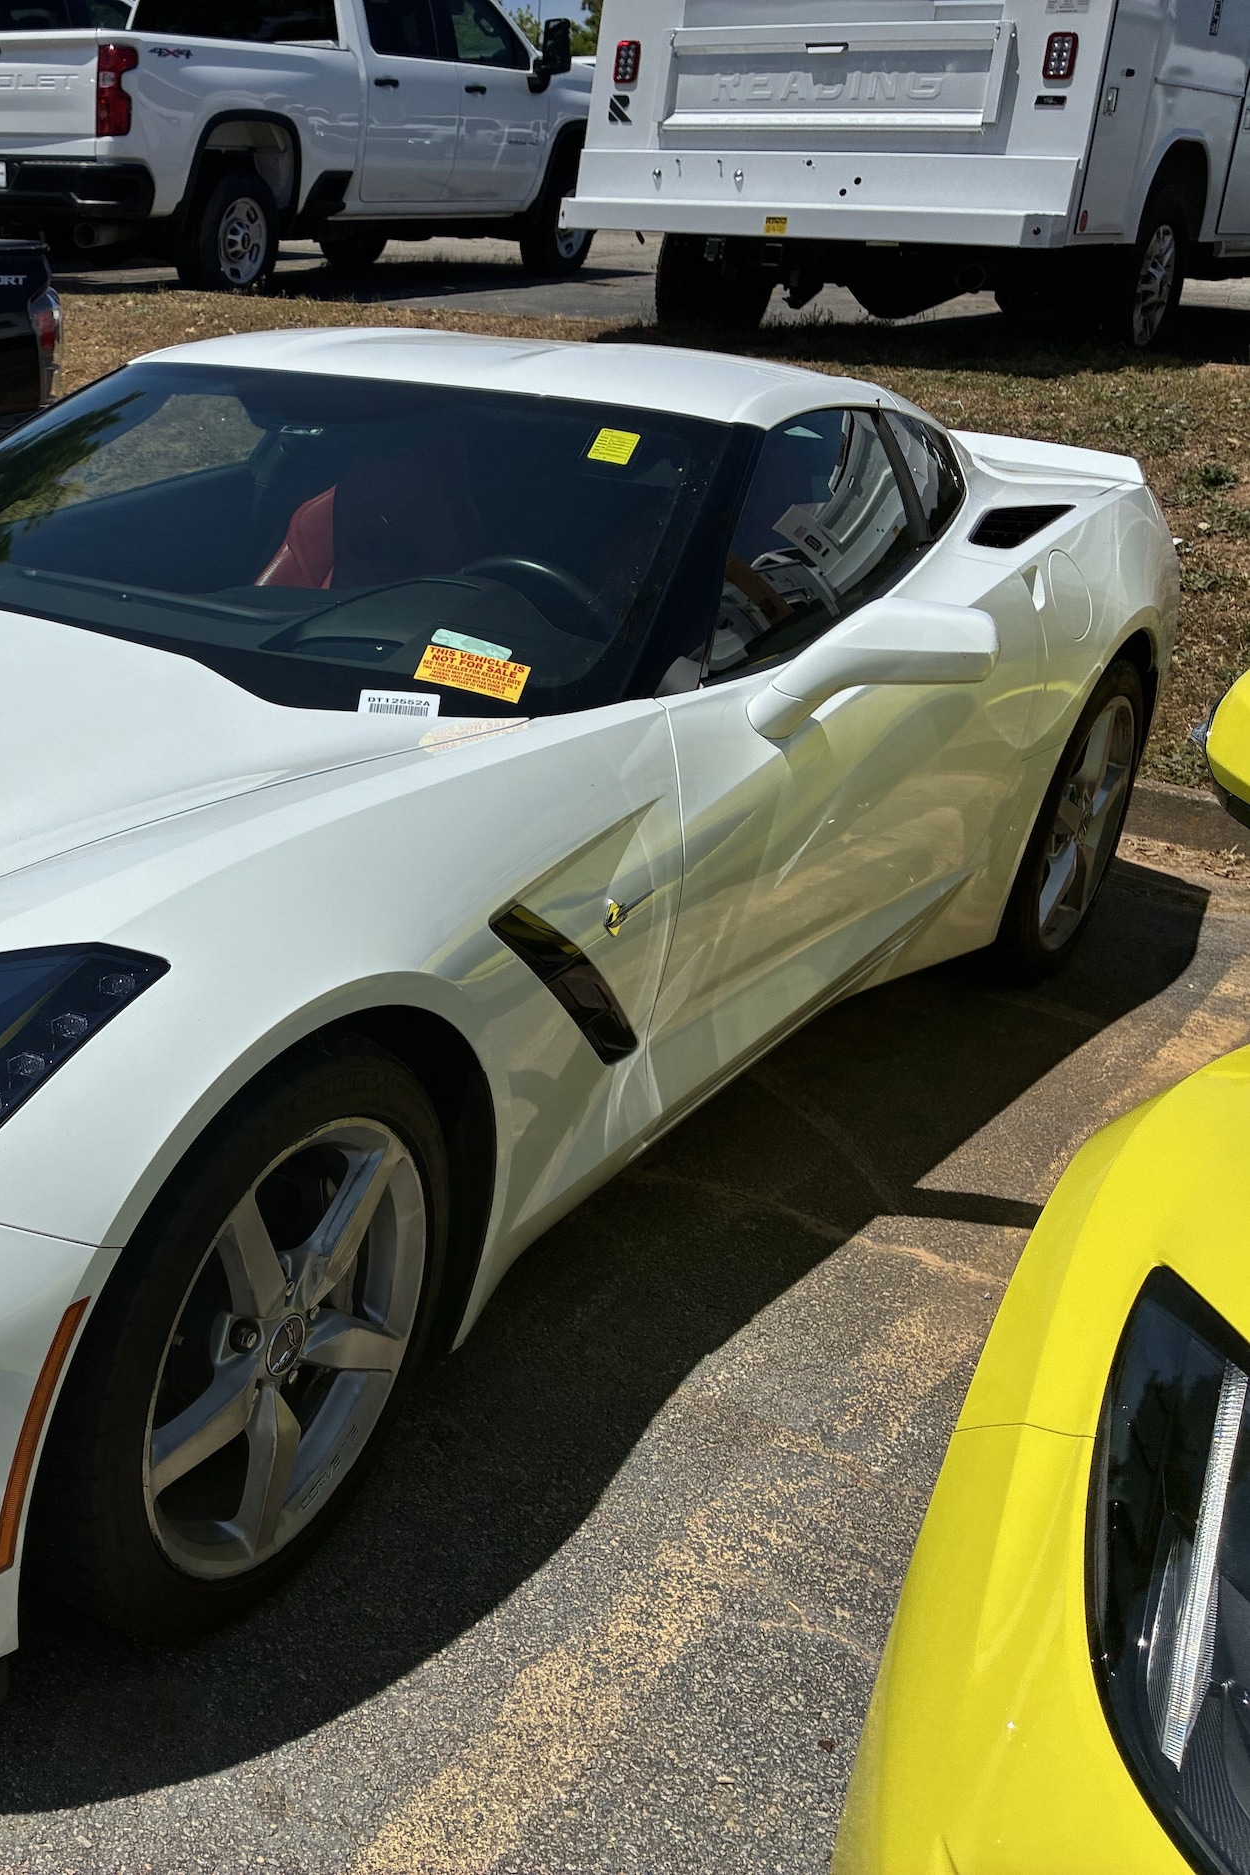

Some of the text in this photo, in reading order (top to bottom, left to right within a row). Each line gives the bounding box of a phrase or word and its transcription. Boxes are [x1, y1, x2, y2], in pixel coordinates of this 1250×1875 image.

[711, 70, 946, 102] READING
[430, 647, 525, 674] THIS VEHICLE IS
[431, 654, 518, 679] NOT FOR SALE
[447, 664, 468, 673] DEALER
[481, 671, 507, 682] RELEASE
[507, 678, 522, 687] DATE
